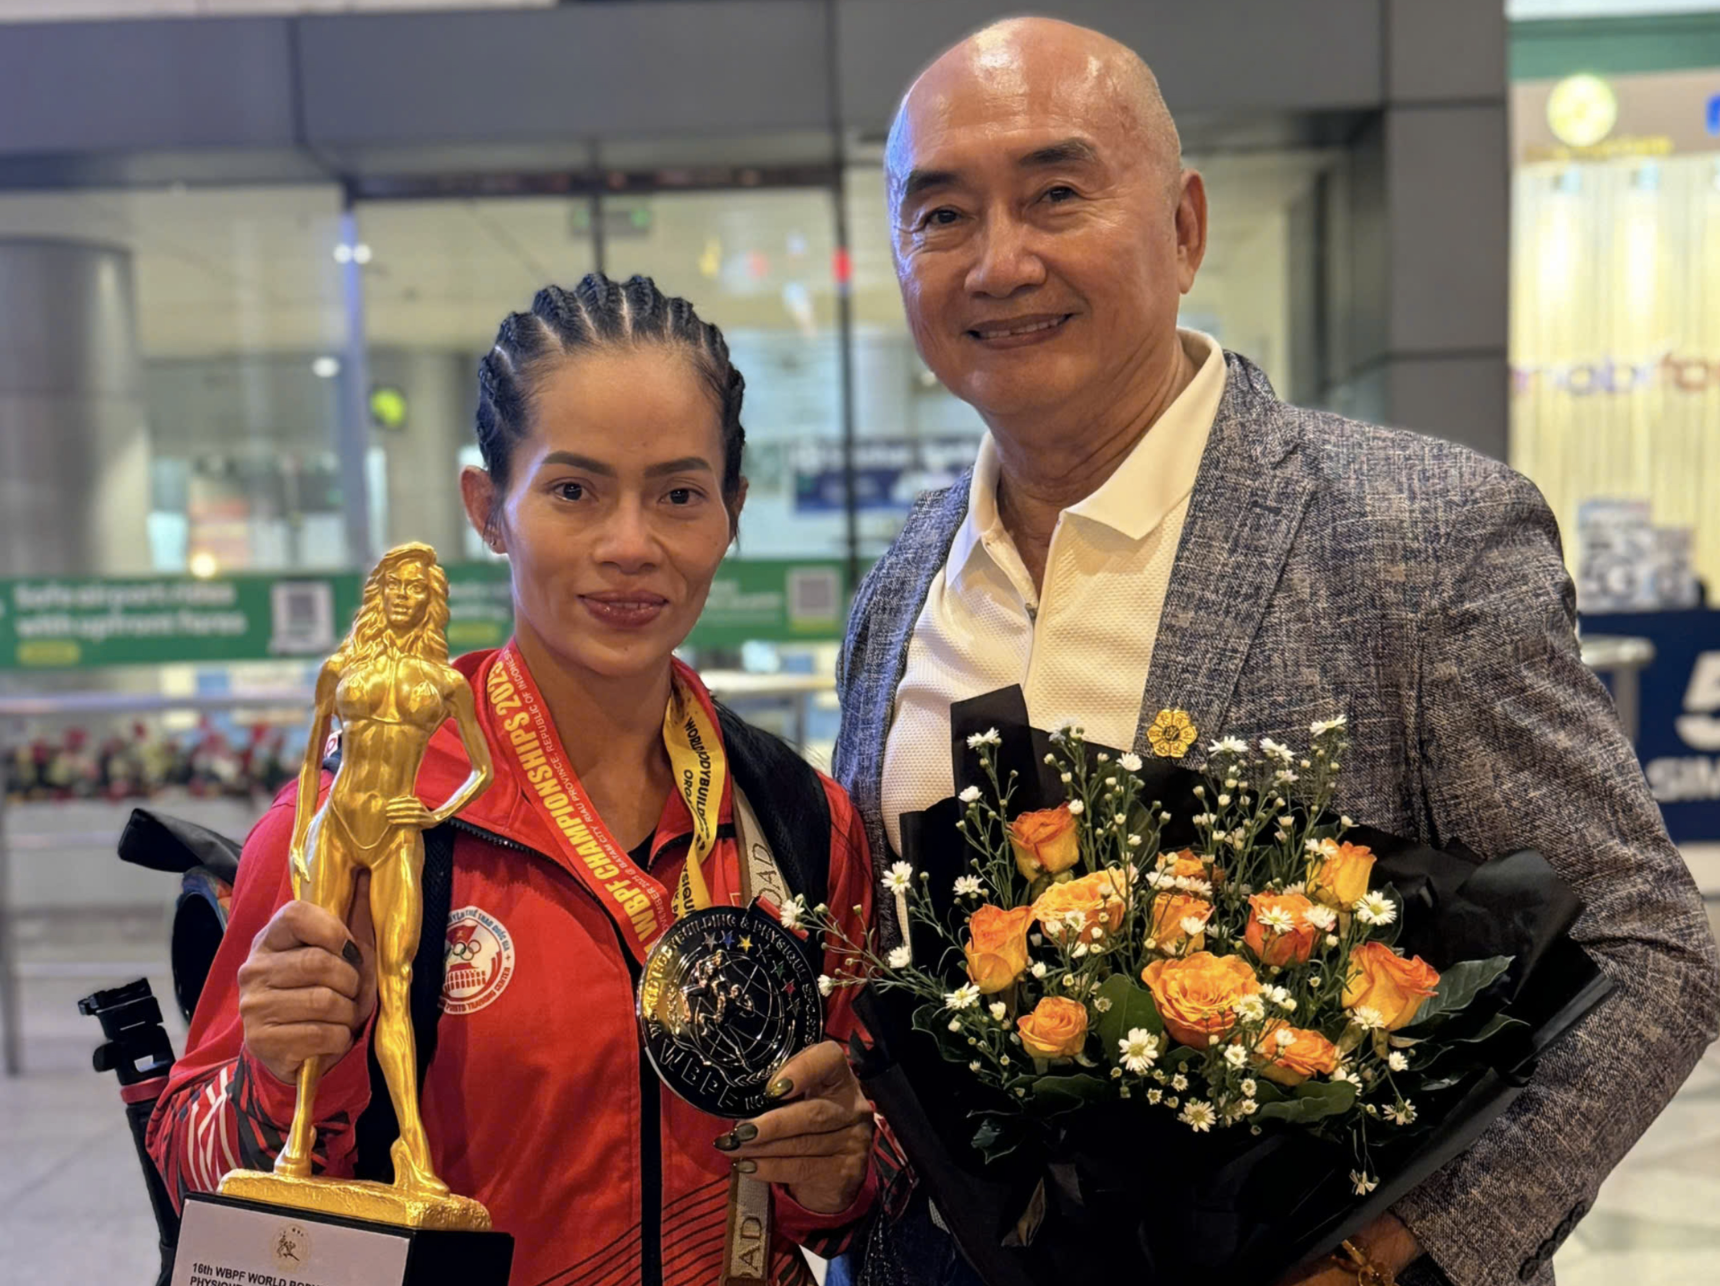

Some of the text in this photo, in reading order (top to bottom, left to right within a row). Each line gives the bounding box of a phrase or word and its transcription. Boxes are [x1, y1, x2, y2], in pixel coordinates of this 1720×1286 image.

[521, 691, 534, 704] OF
[529, 704, 555, 752] REPUBLIC
[504, 712, 621, 881] CHAMPIONSHIPS
[576, 802, 593, 823] RIAU
[590, 825, 610, 848] CITY
[607, 846, 629, 869] BATAM
[604, 879, 659, 942] WBPF
[646, 885, 670, 935] OVEMBER
[193, 1262, 213, 1276] 16th
[216, 1266, 246, 1281] WBPF
[248, 1272, 287, 1286] WORLD
